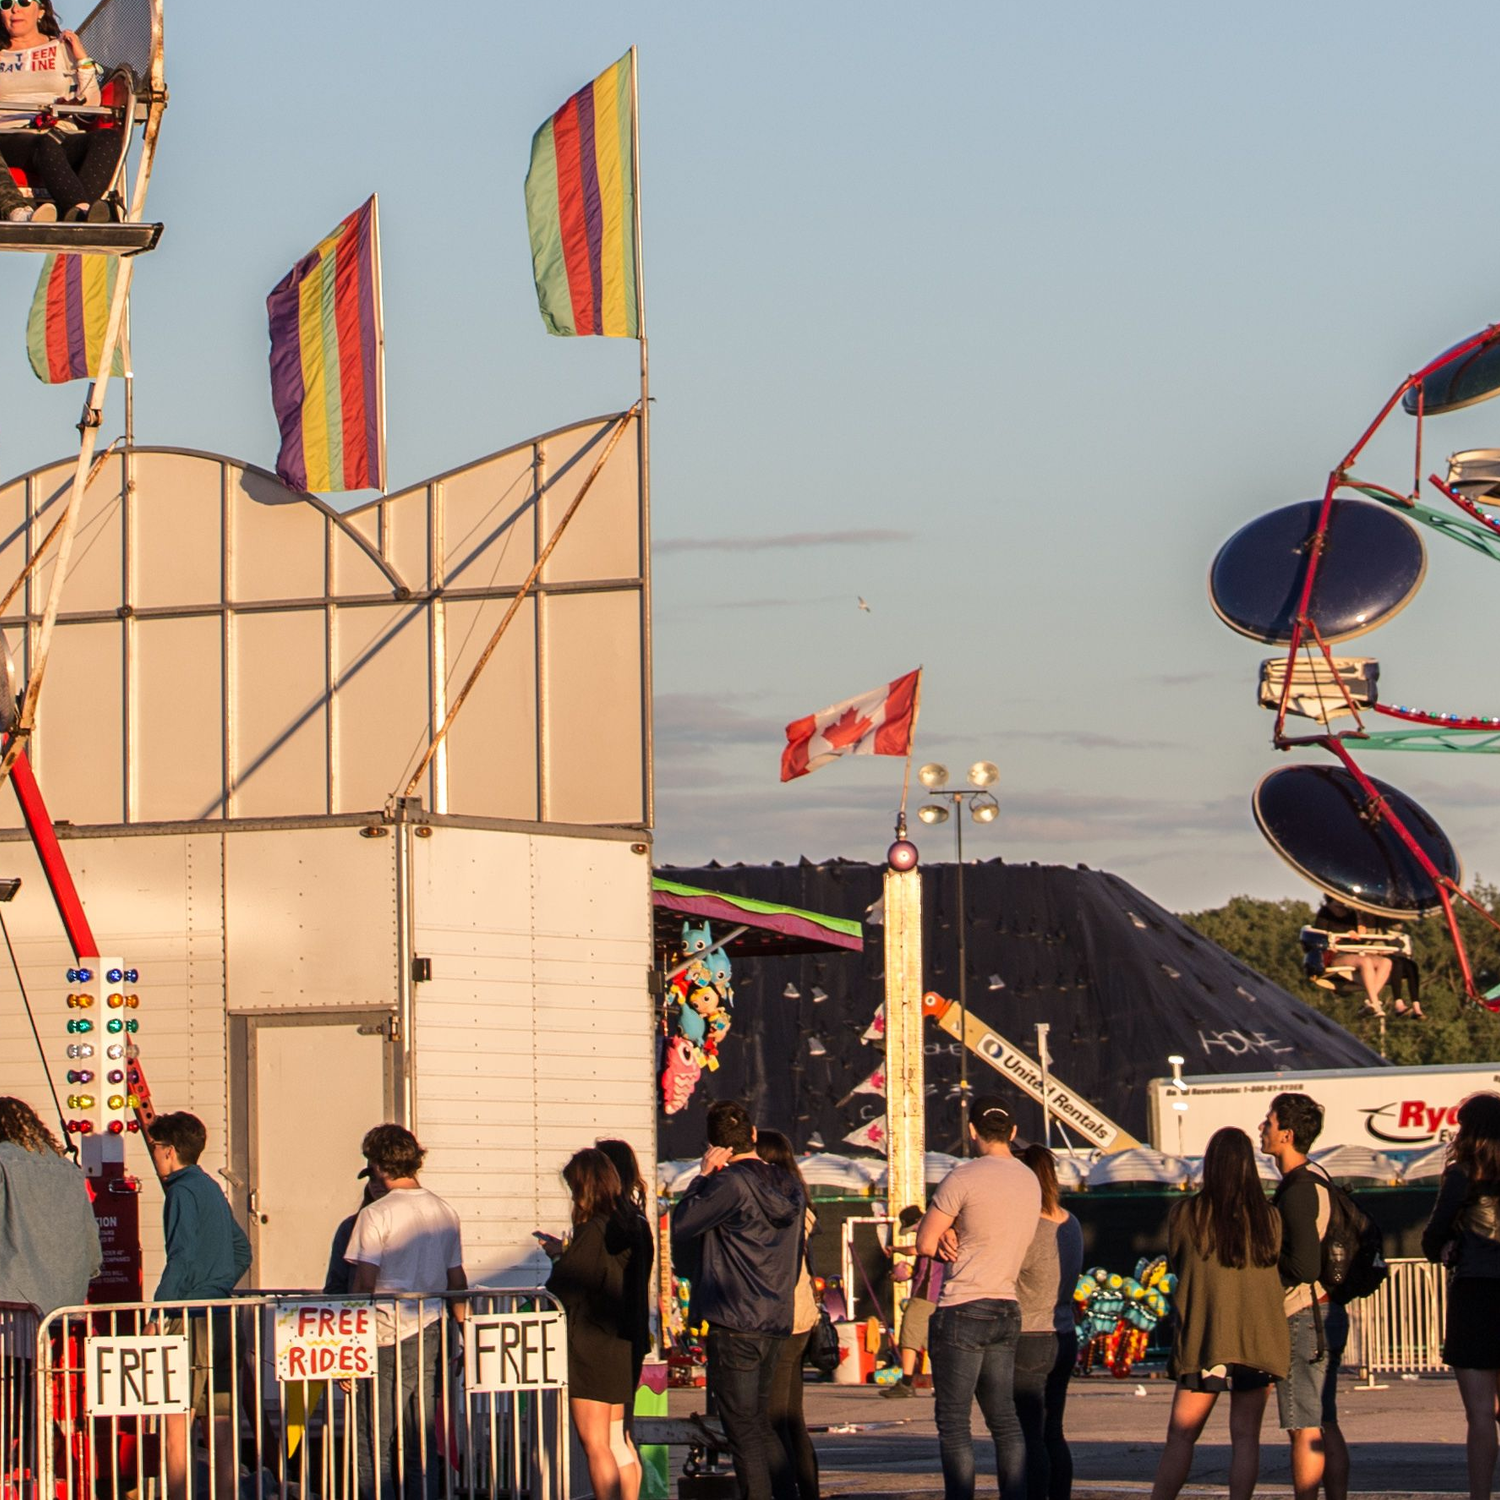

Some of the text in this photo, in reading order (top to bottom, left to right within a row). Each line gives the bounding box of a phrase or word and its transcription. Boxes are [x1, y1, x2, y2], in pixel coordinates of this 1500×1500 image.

[1052, 1093, 1108, 1139] Rentals
[299, 1307, 368, 1337] FREE
[290, 1346, 368, 1376] RIDES
[476, 1319, 558, 1385] FREE
[97, 1346, 181, 1406] FREE
